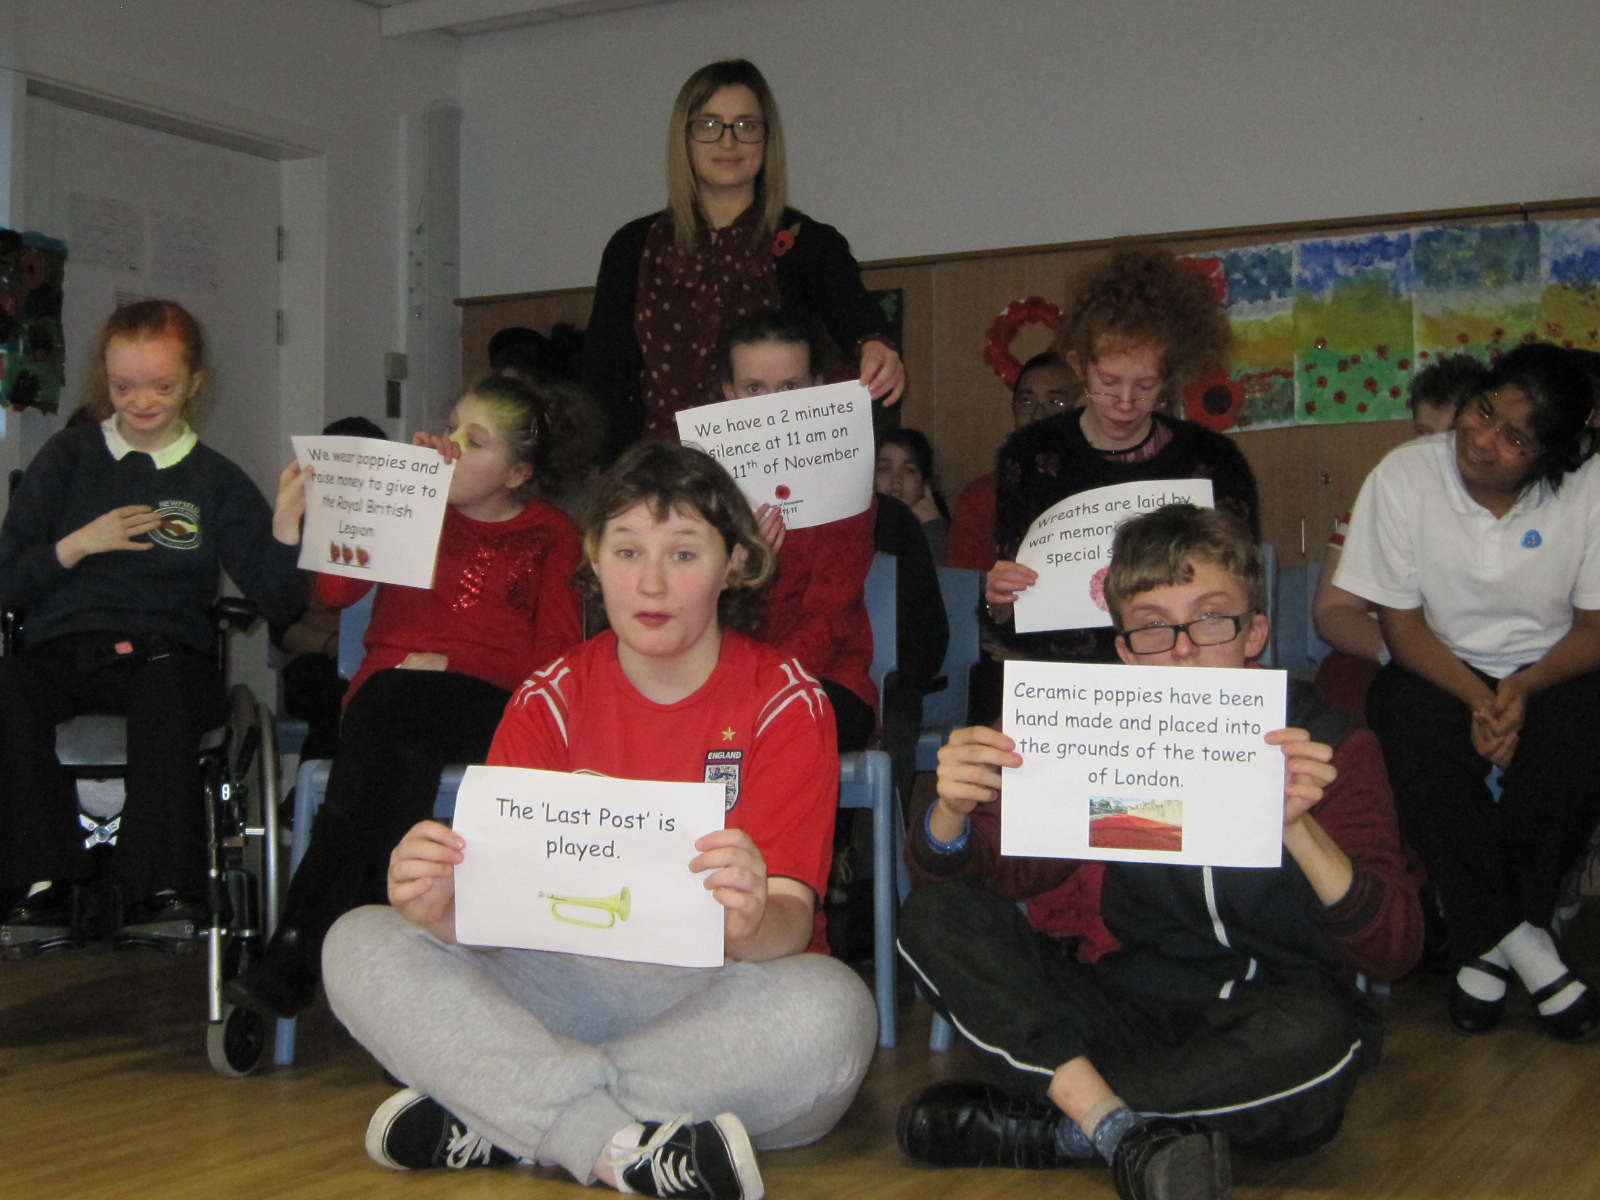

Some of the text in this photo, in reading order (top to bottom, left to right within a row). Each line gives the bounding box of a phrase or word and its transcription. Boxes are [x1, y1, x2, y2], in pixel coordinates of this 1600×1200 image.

[694, 401, 854, 438] We have a 2 minutes
[708, 426, 848, 459] silence at 11 am on
[307, 448, 440, 475] We wear poppies and
[732, 446, 860, 480] 11th of November
[311, 471, 437, 499] raise money to give to
[322, 494, 413, 519] the Royal British
[1104, 499, 1132, 512] are
[1137, 492, 1166, 509] laid
[338, 520, 375, 539] Legion
[1060, 520, 1117, 541] memori
[1046, 545, 1100, 568] special
[1013, 682, 1264, 708] Ceramic poppies have been
[1015, 709, 1262, 736] hand made and placed into
[707, 751, 742, 760] ENGLAND
[1019, 737, 1257, 763] the grounds of the tower
[1087, 767, 1185, 788] of London.
[495, 797, 535, 820] The
[658, 813, 676, 832] is
[546, 835, 621, 862] played.
